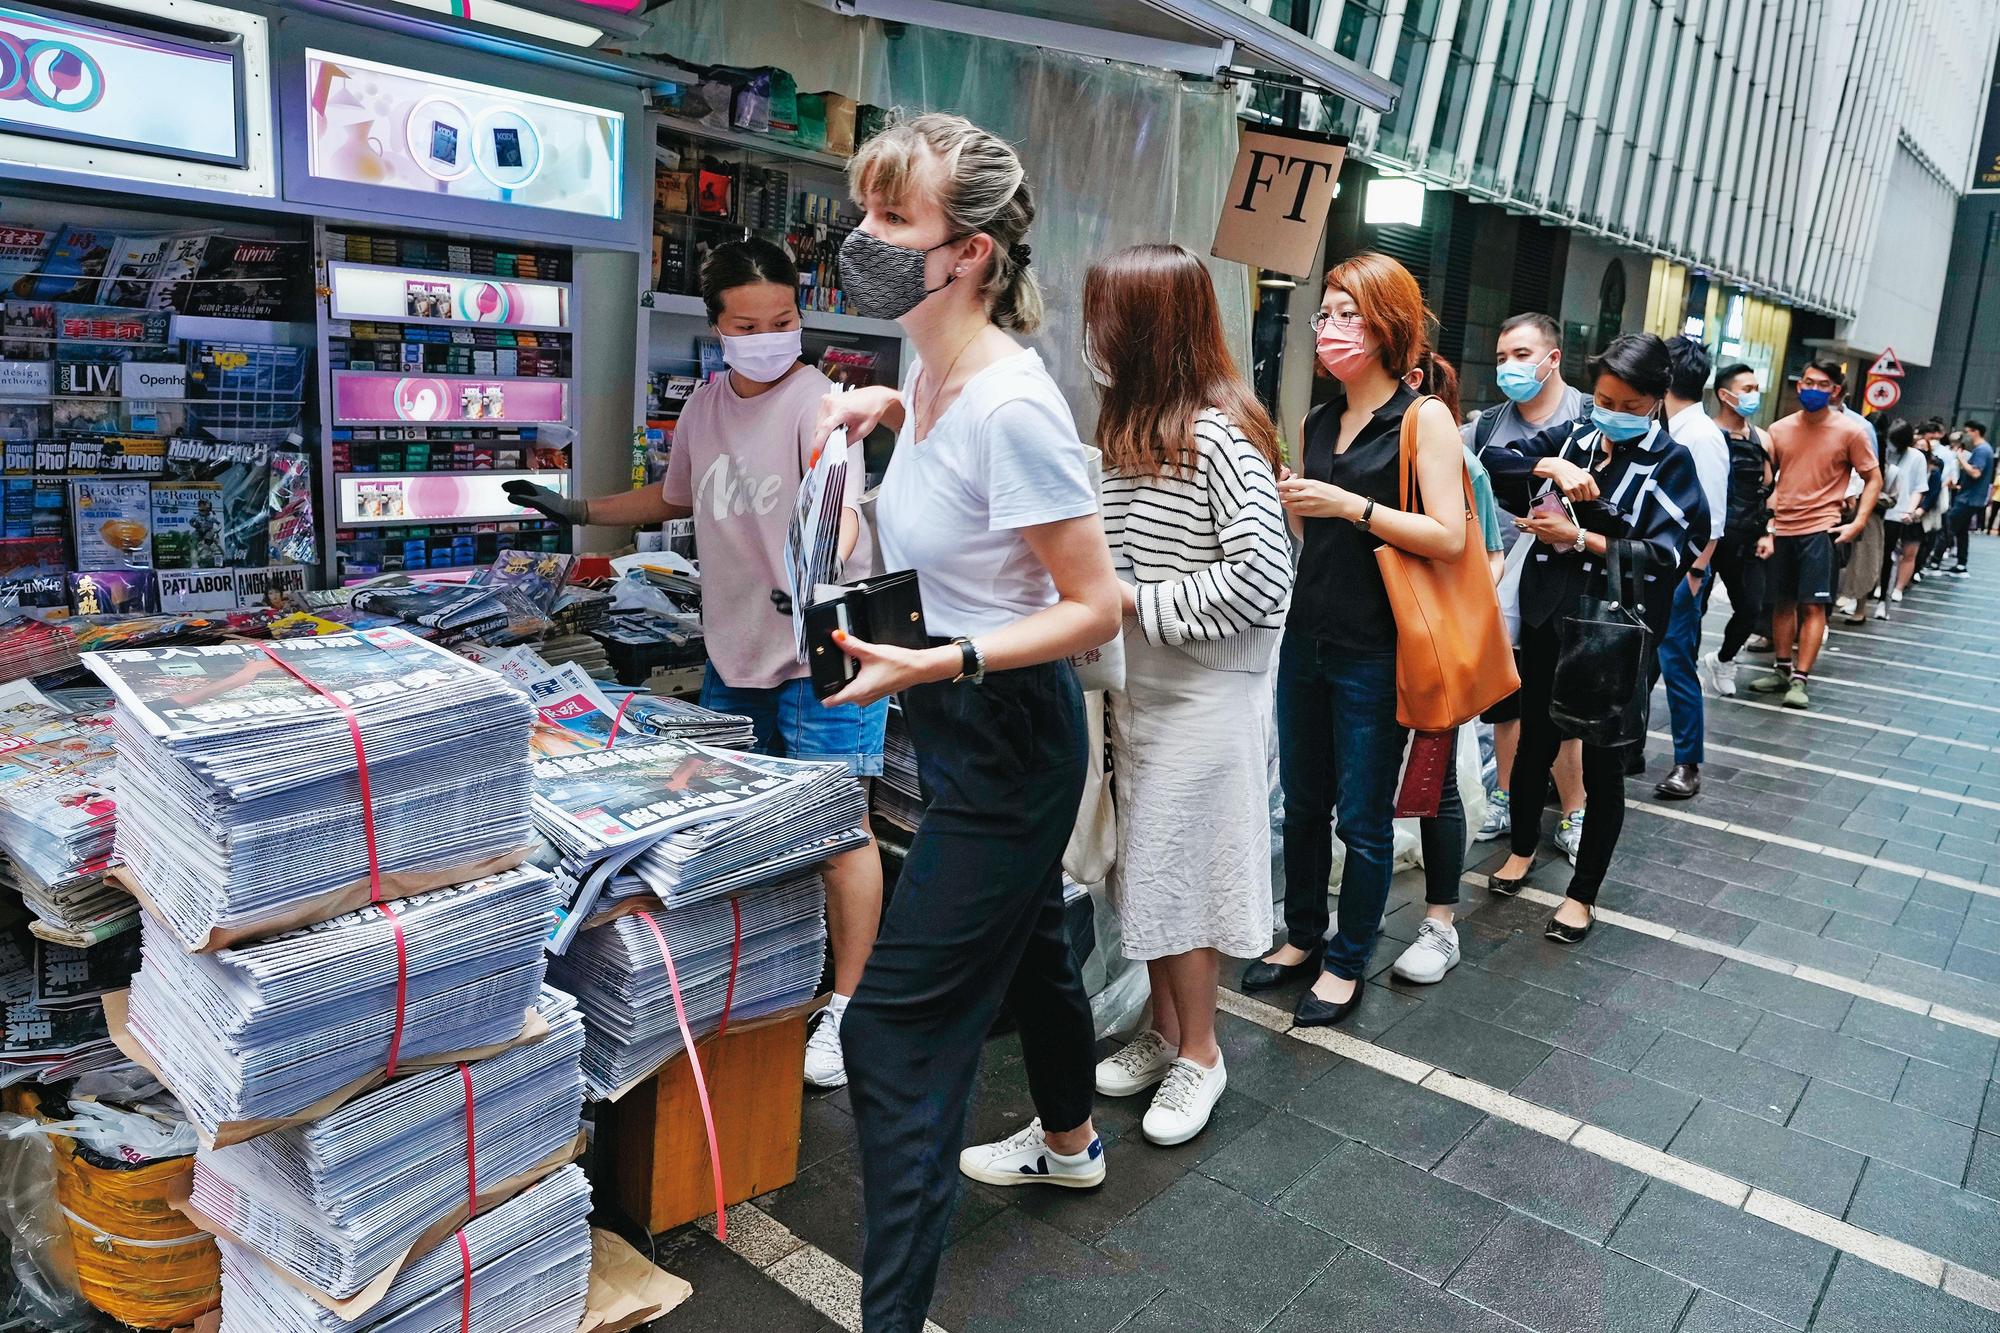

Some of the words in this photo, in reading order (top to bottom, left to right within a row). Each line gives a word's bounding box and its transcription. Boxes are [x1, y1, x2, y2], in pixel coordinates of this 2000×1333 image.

[1234, 150, 1333, 223] FT
[695, 453, 783, 521] Nice
[162, 575, 233, 596] PATLABOR
